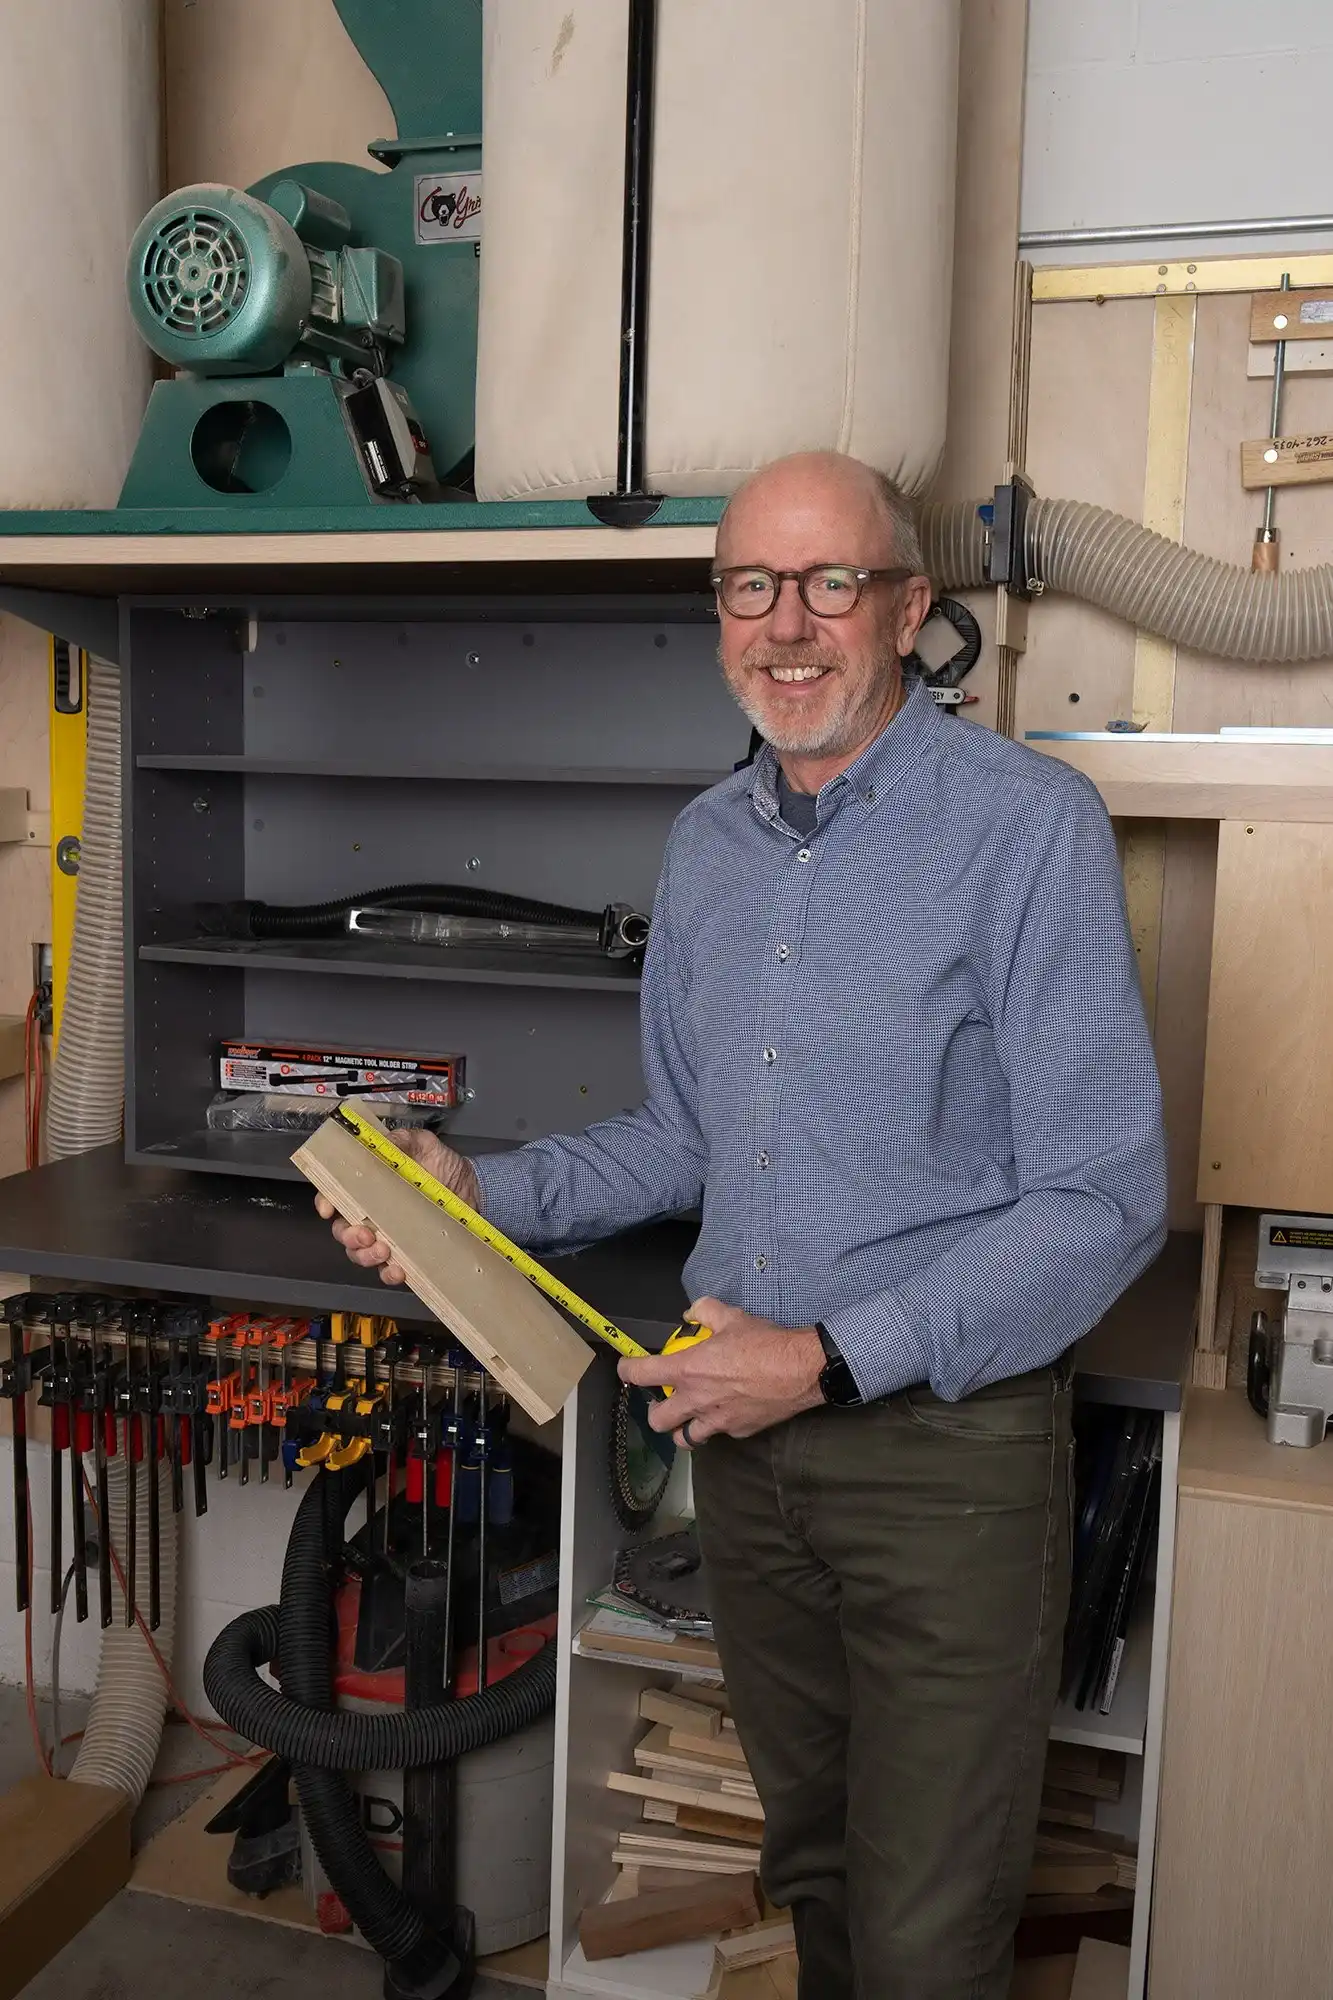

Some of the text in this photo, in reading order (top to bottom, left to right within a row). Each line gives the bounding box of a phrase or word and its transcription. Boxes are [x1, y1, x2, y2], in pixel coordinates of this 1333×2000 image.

[930, 691, 945, 700] SEY
[335, 1056, 363, 1066] MAGNETIC
[364, 1058, 378, 1067] TOOL
[379, 1060, 401, 1069] HOLDER
[402, 1062, 418, 1071] STRIP
[391, 1161, 399, 1169] 3
[437, 1198, 445, 1206] 5
[460, 1217, 468, 1225] 6
[484, 1235, 491, 1243] 7
[529, 1273, 537, 1281] 9
[364, 1794, 404, 1835] D
